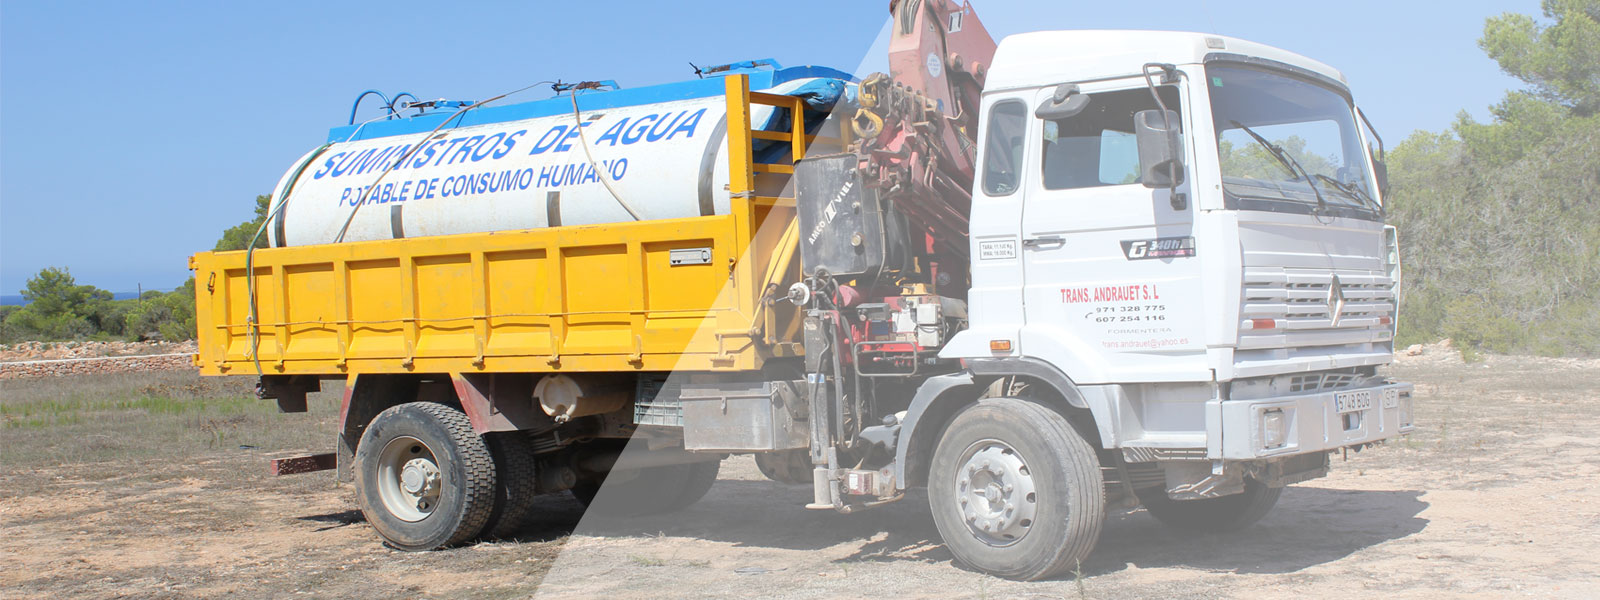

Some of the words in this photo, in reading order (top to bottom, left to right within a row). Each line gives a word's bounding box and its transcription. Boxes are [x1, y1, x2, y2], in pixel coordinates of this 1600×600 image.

[314, 129, 528, 180] SUMINISTROS
[529, 121, 593, 156] DE
[594, 107, 708, 147] AGUA
[413, 177, 440, 201] DE
[440, 167, 534, 200] CONSUMO
[808, 221, 825, 245] AMCO
[834, 181, 853, 202] VIEL
[1128, 241, 1147, 258] G
[1061, 288, 1092, 303] TRANS.
[1093, 285, 1140, 302] ANDRAUET
[1143, 284, 1152, 300] S.
[1153, 284, 1159, 300] L
[1339, 394, 1354, 410] 5748
